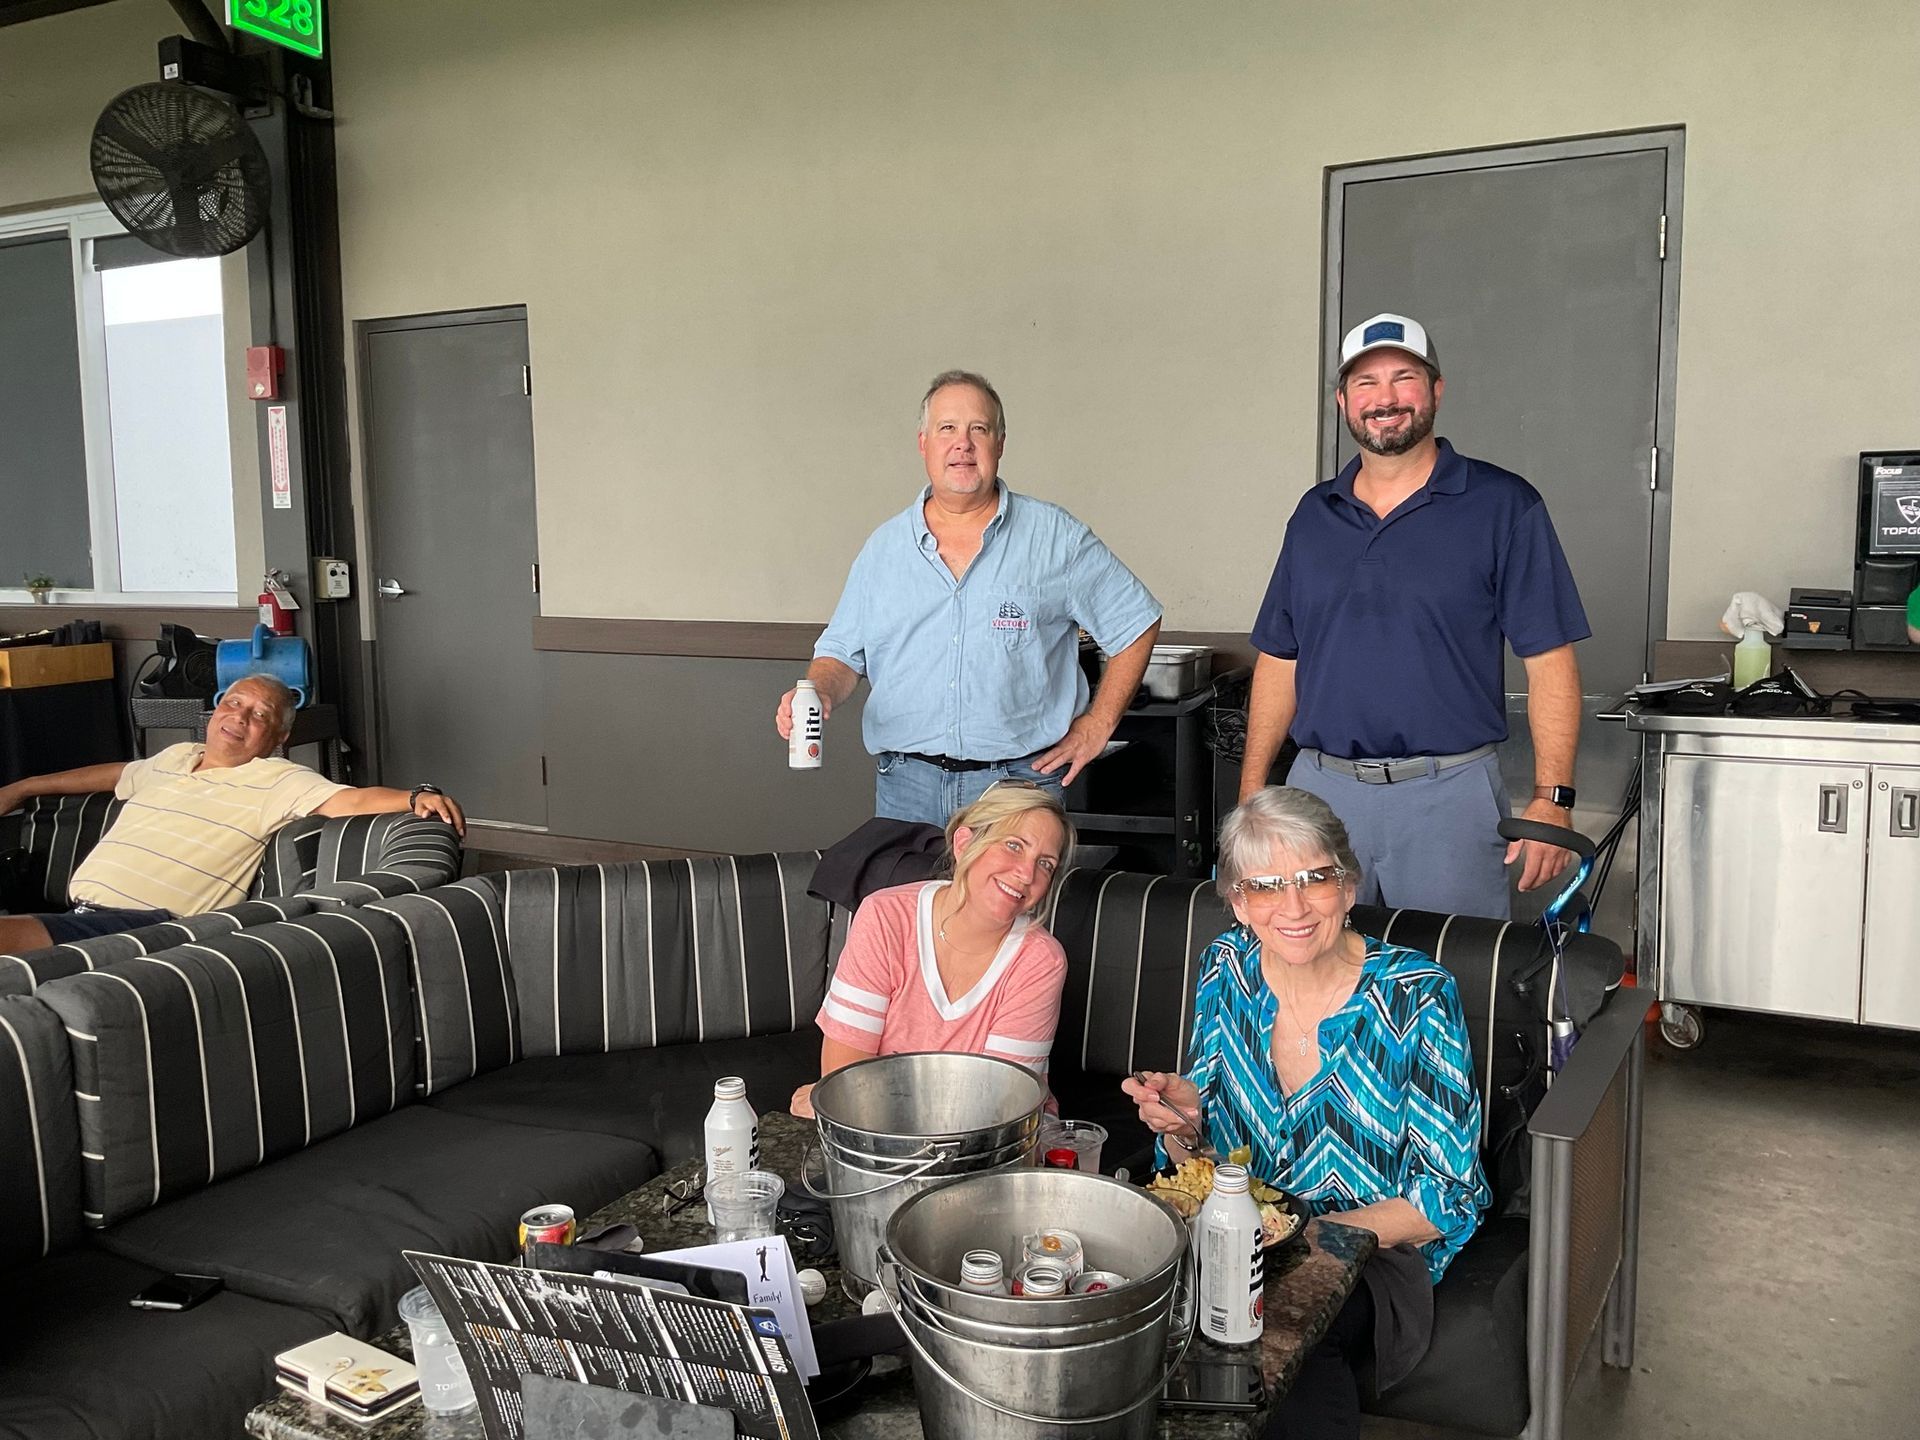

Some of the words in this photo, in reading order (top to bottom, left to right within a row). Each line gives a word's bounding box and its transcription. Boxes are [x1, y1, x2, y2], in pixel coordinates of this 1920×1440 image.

[992, 619, 1029, 628] VICTORY
[805, 706, 821, 741] lite
[752, 1290, 783, 1304] Family!
[760, 1336, 789, 1374] DRINKS
